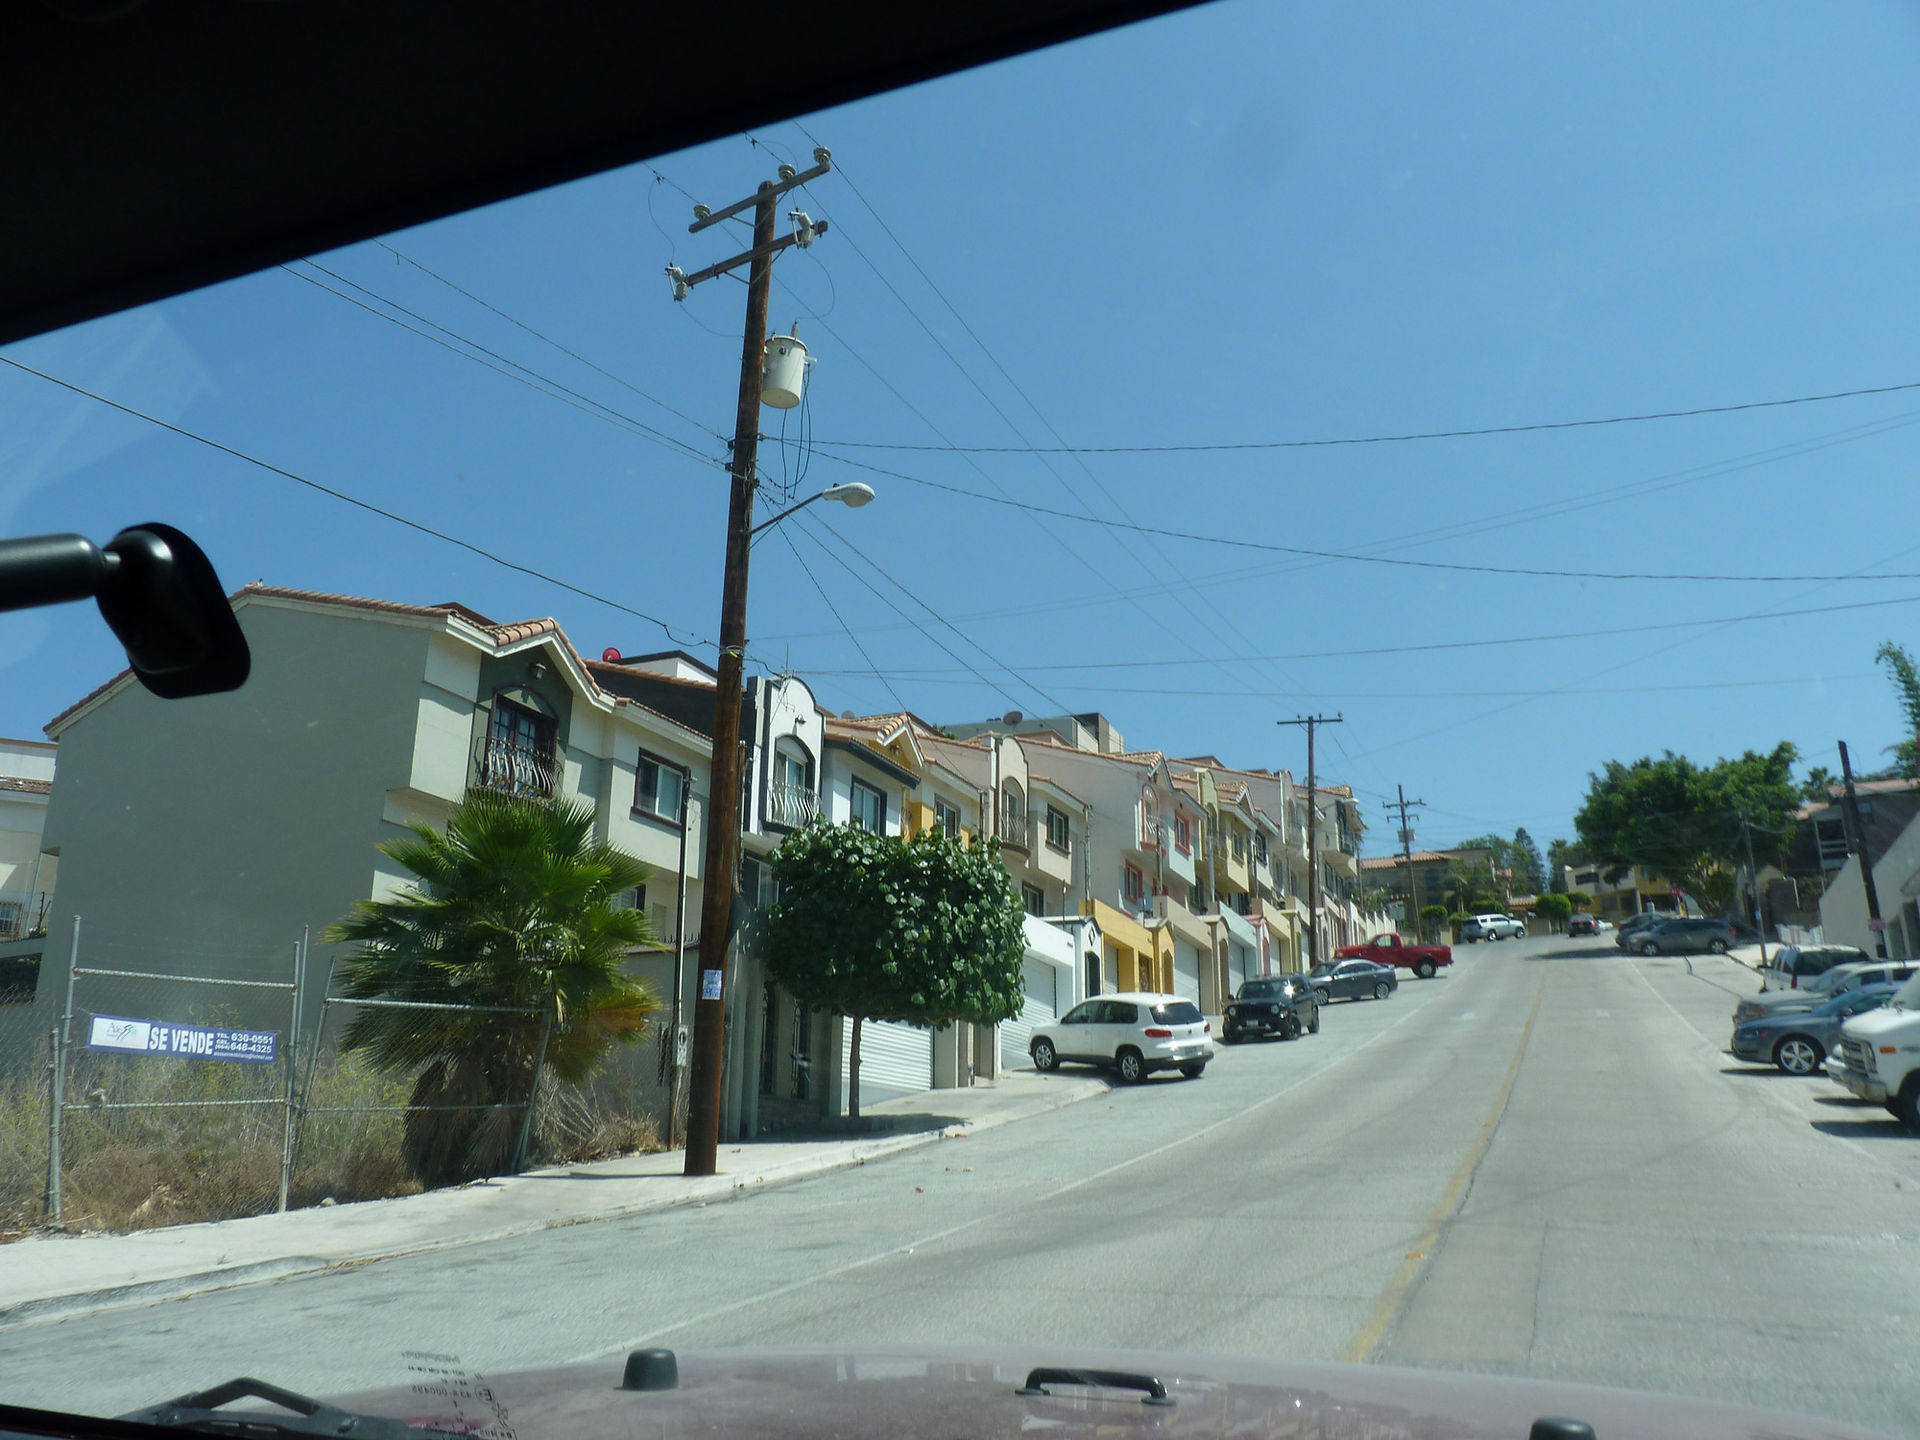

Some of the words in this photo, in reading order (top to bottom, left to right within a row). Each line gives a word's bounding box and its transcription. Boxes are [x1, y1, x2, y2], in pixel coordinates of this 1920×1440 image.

[149, 1026, 169, 1051] SE
[171, 1028, 215, 1055] VENDE
[231, 1032, 273, 1045] 630-0551
[230, 1042, 272, 1054] 648-4325
